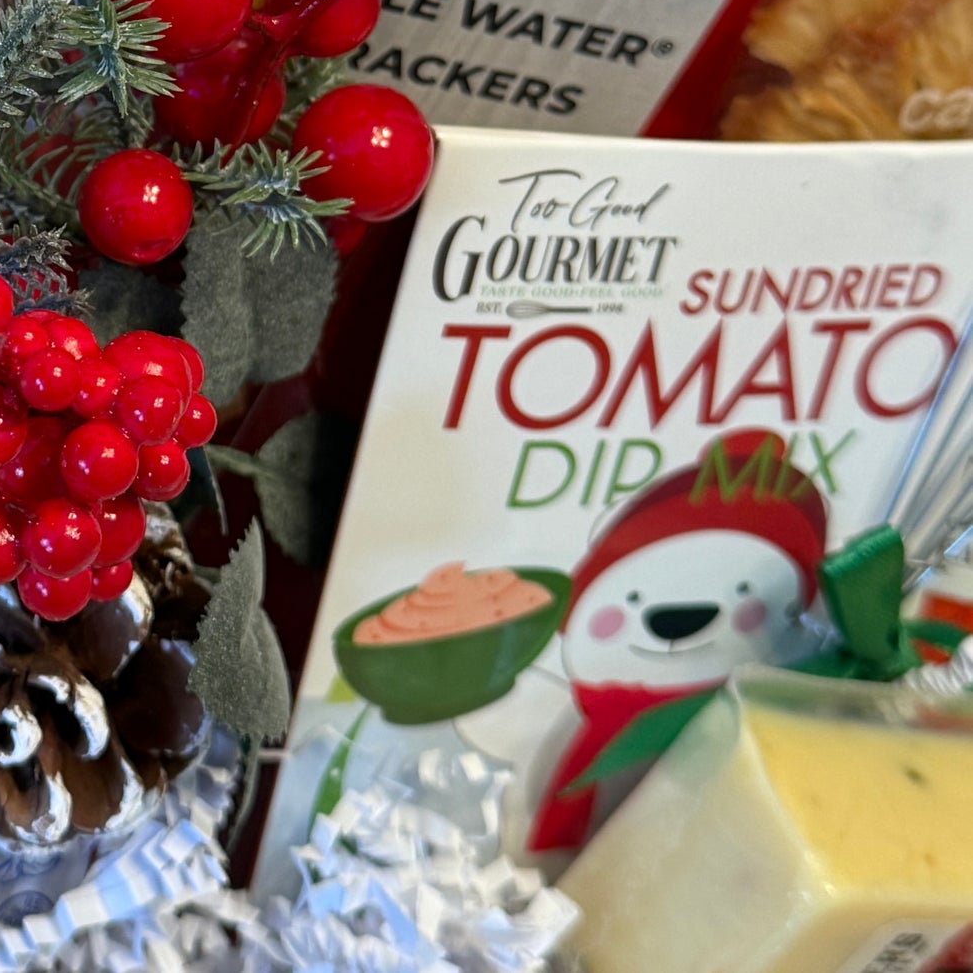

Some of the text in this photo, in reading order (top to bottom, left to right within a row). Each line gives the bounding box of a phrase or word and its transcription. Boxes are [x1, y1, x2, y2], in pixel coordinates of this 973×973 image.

[498, 169, 670, 233] Too Good
[432, 215, 678, 303] GOURMET
[678, 263, 943, 317] SUNDRIED
[442, 316, 958, 430] TOMATO
[506, 429, 856, 510] DIP MIX
